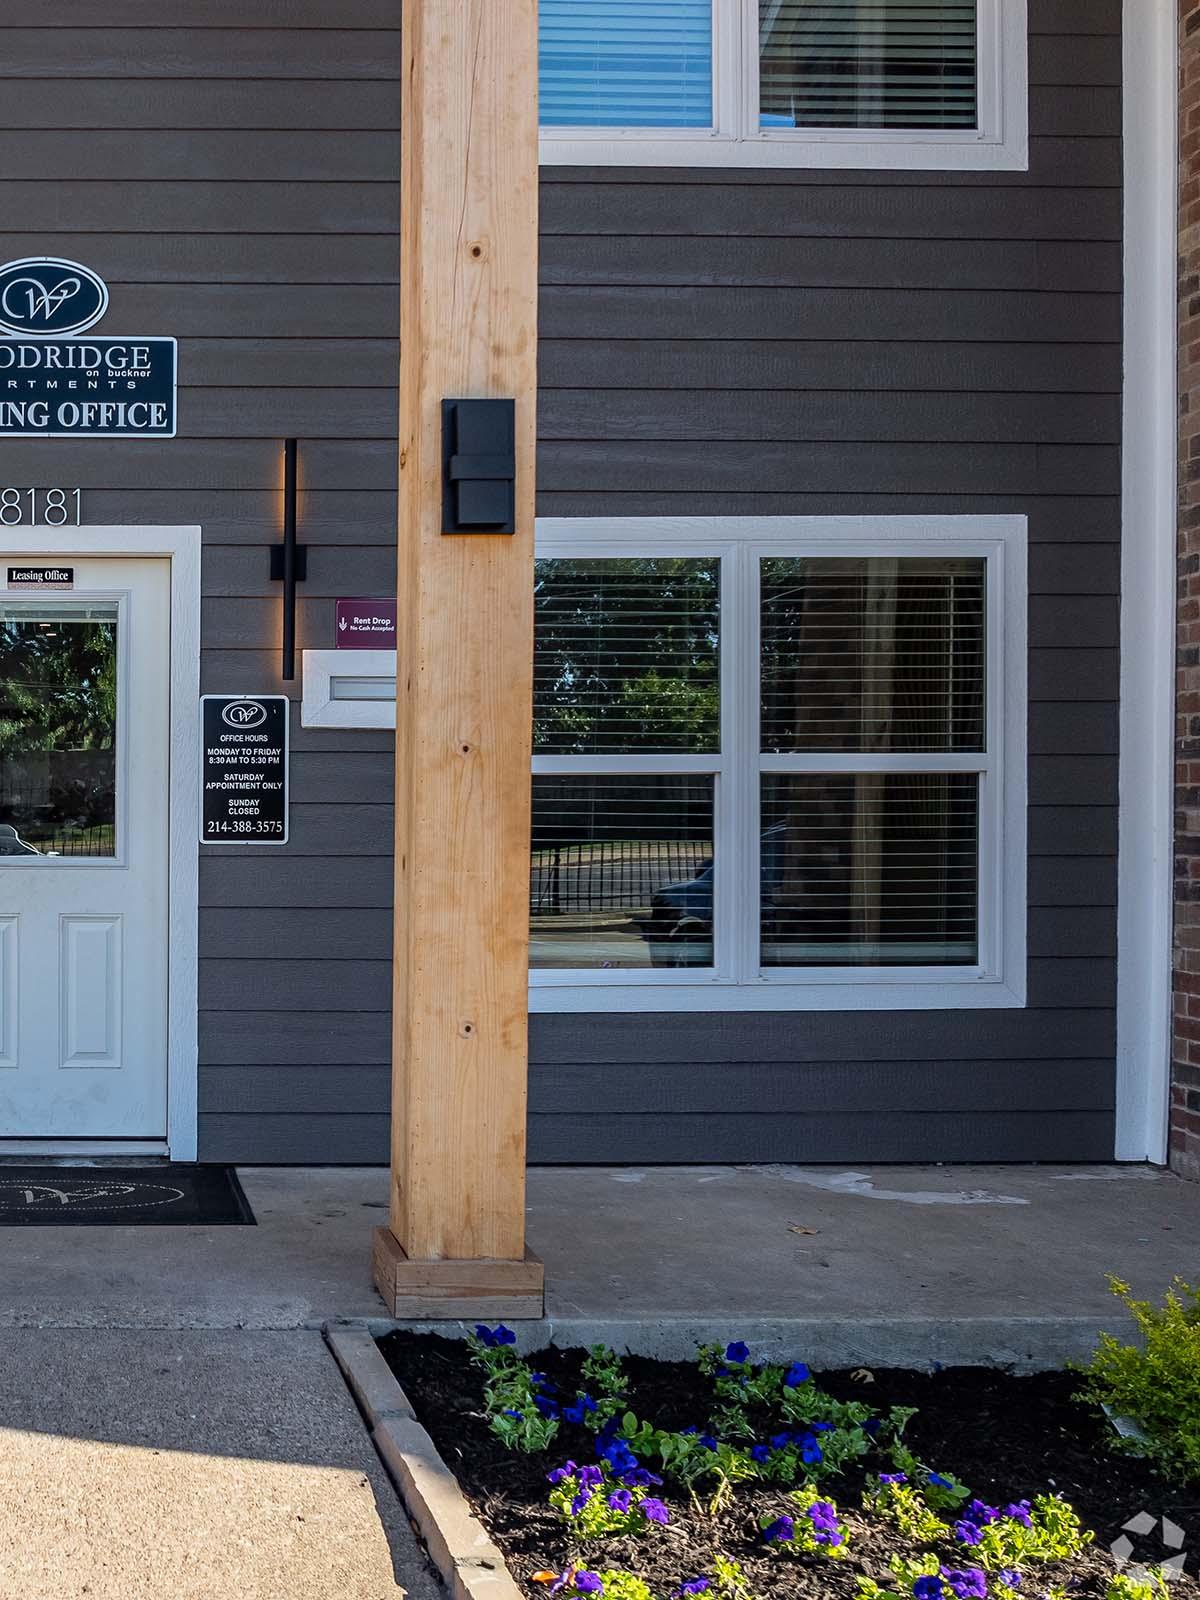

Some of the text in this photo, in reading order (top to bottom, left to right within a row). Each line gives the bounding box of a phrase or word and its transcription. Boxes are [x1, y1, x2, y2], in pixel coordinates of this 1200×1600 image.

[107, 369, 151, 377] buckner
[57, 402, 168, 428] OFFICE
[0, 488, 81, 526] 8181
[12, 569, 69, 582] Leasing Office
[353, 616, 391, 626] Rent Drop
[224, 773, 264, 781] SATURDAY
[228, 807, 260, 815] CLOSED
[207, 820, 283, 833] 214-388-3575
